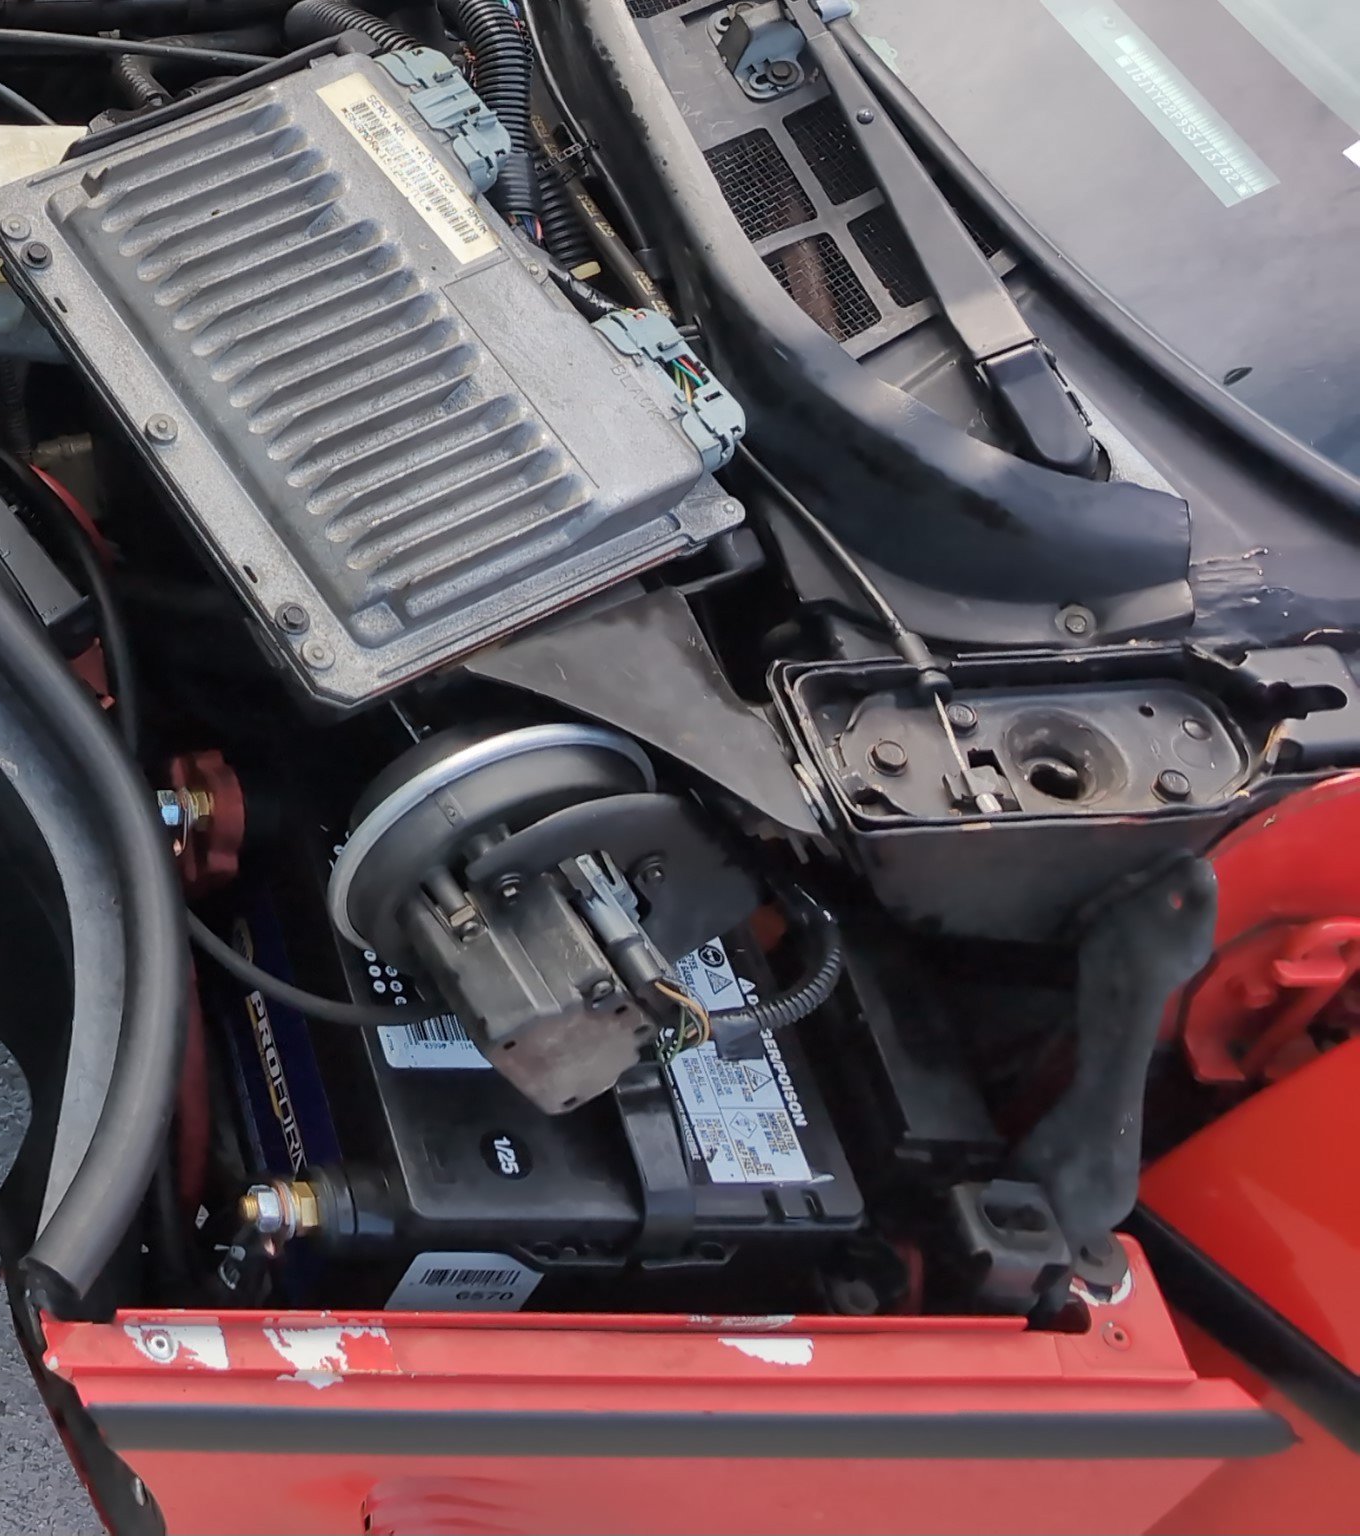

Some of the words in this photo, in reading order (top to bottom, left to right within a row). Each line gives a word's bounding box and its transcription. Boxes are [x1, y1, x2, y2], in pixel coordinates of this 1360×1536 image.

[1125, 65, 1239, 184] 1G1YY22P9S5115762
[744, 992, 807, 1127] DGER/POISON
[493, 1135, 519, 1174] 1/25
